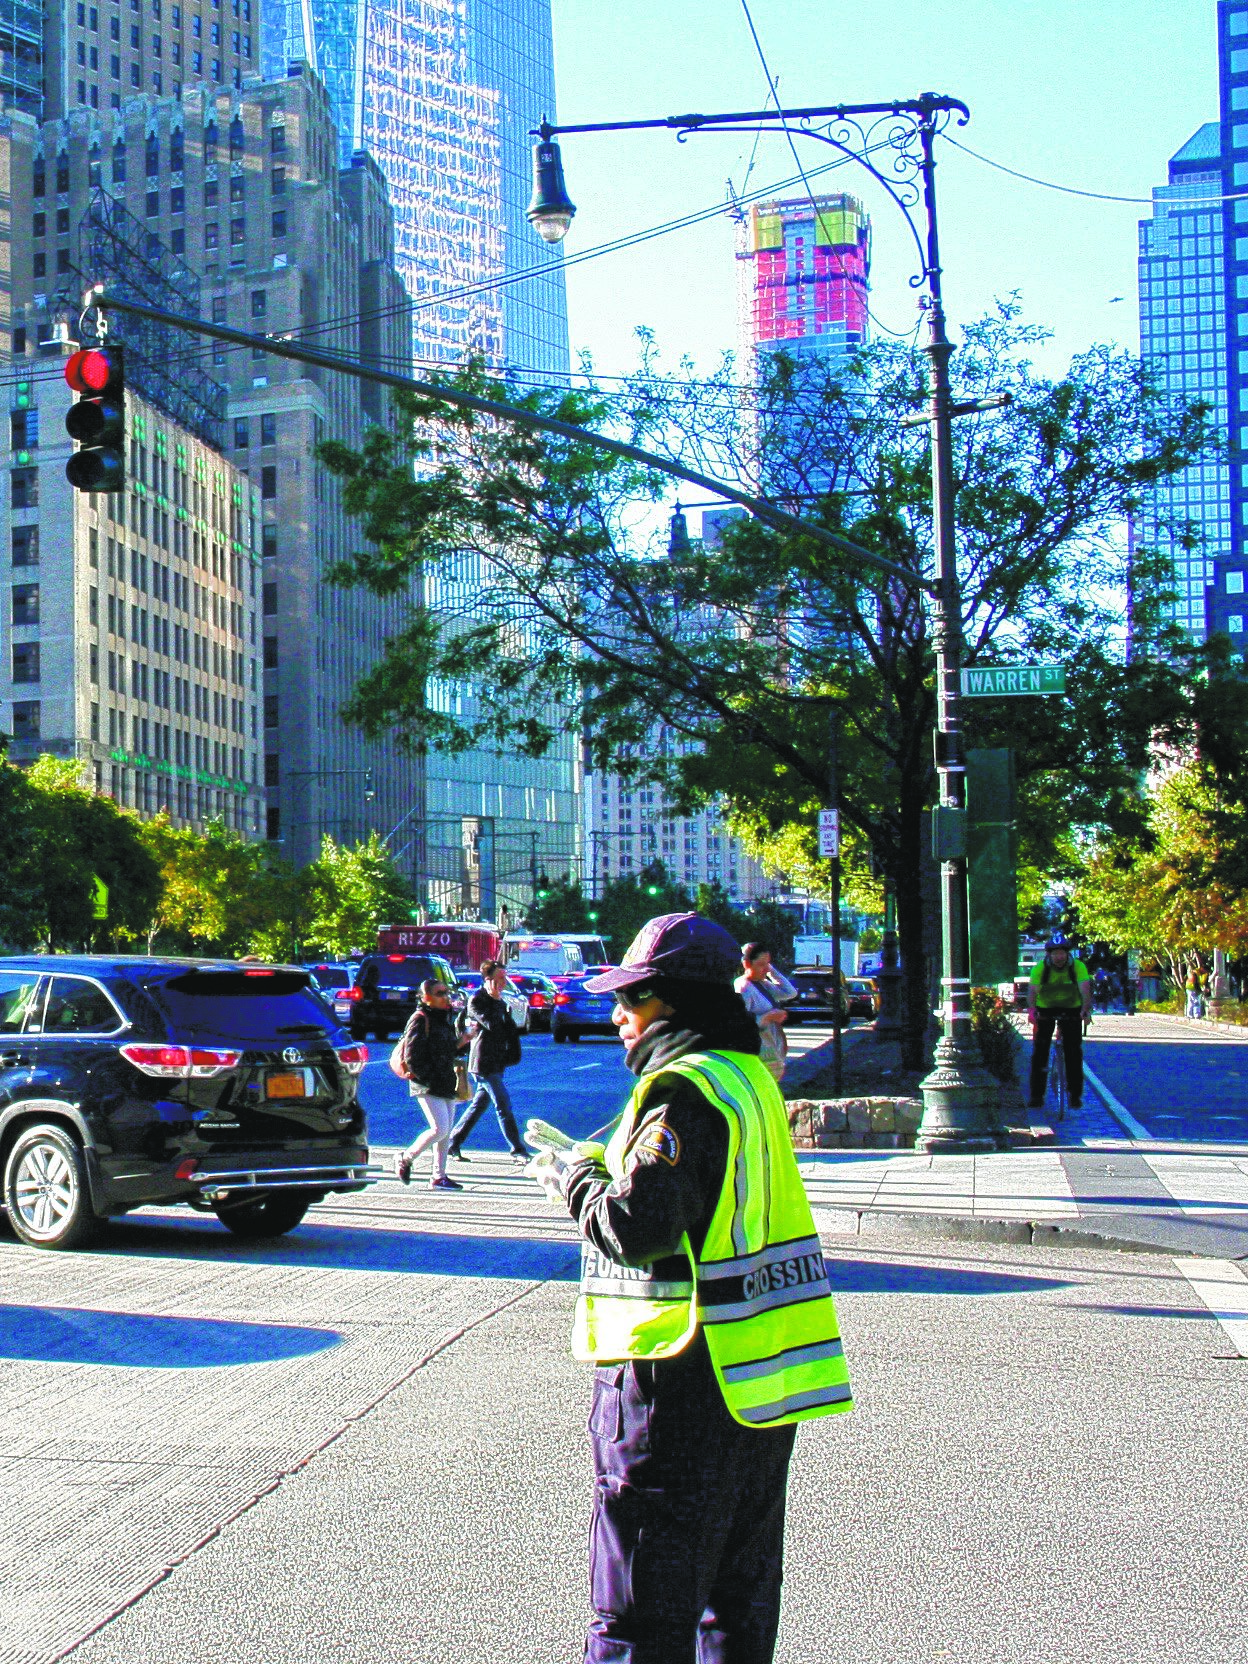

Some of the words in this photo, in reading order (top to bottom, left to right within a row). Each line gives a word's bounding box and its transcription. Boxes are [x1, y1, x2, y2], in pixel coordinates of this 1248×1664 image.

[969, 670, 1041, 692] WARREN
[1044, 669, 1061, 681] ST
[398, 932, 451, 946] RIZZO
[742, 1252, 827, 1301] CROSSIN
